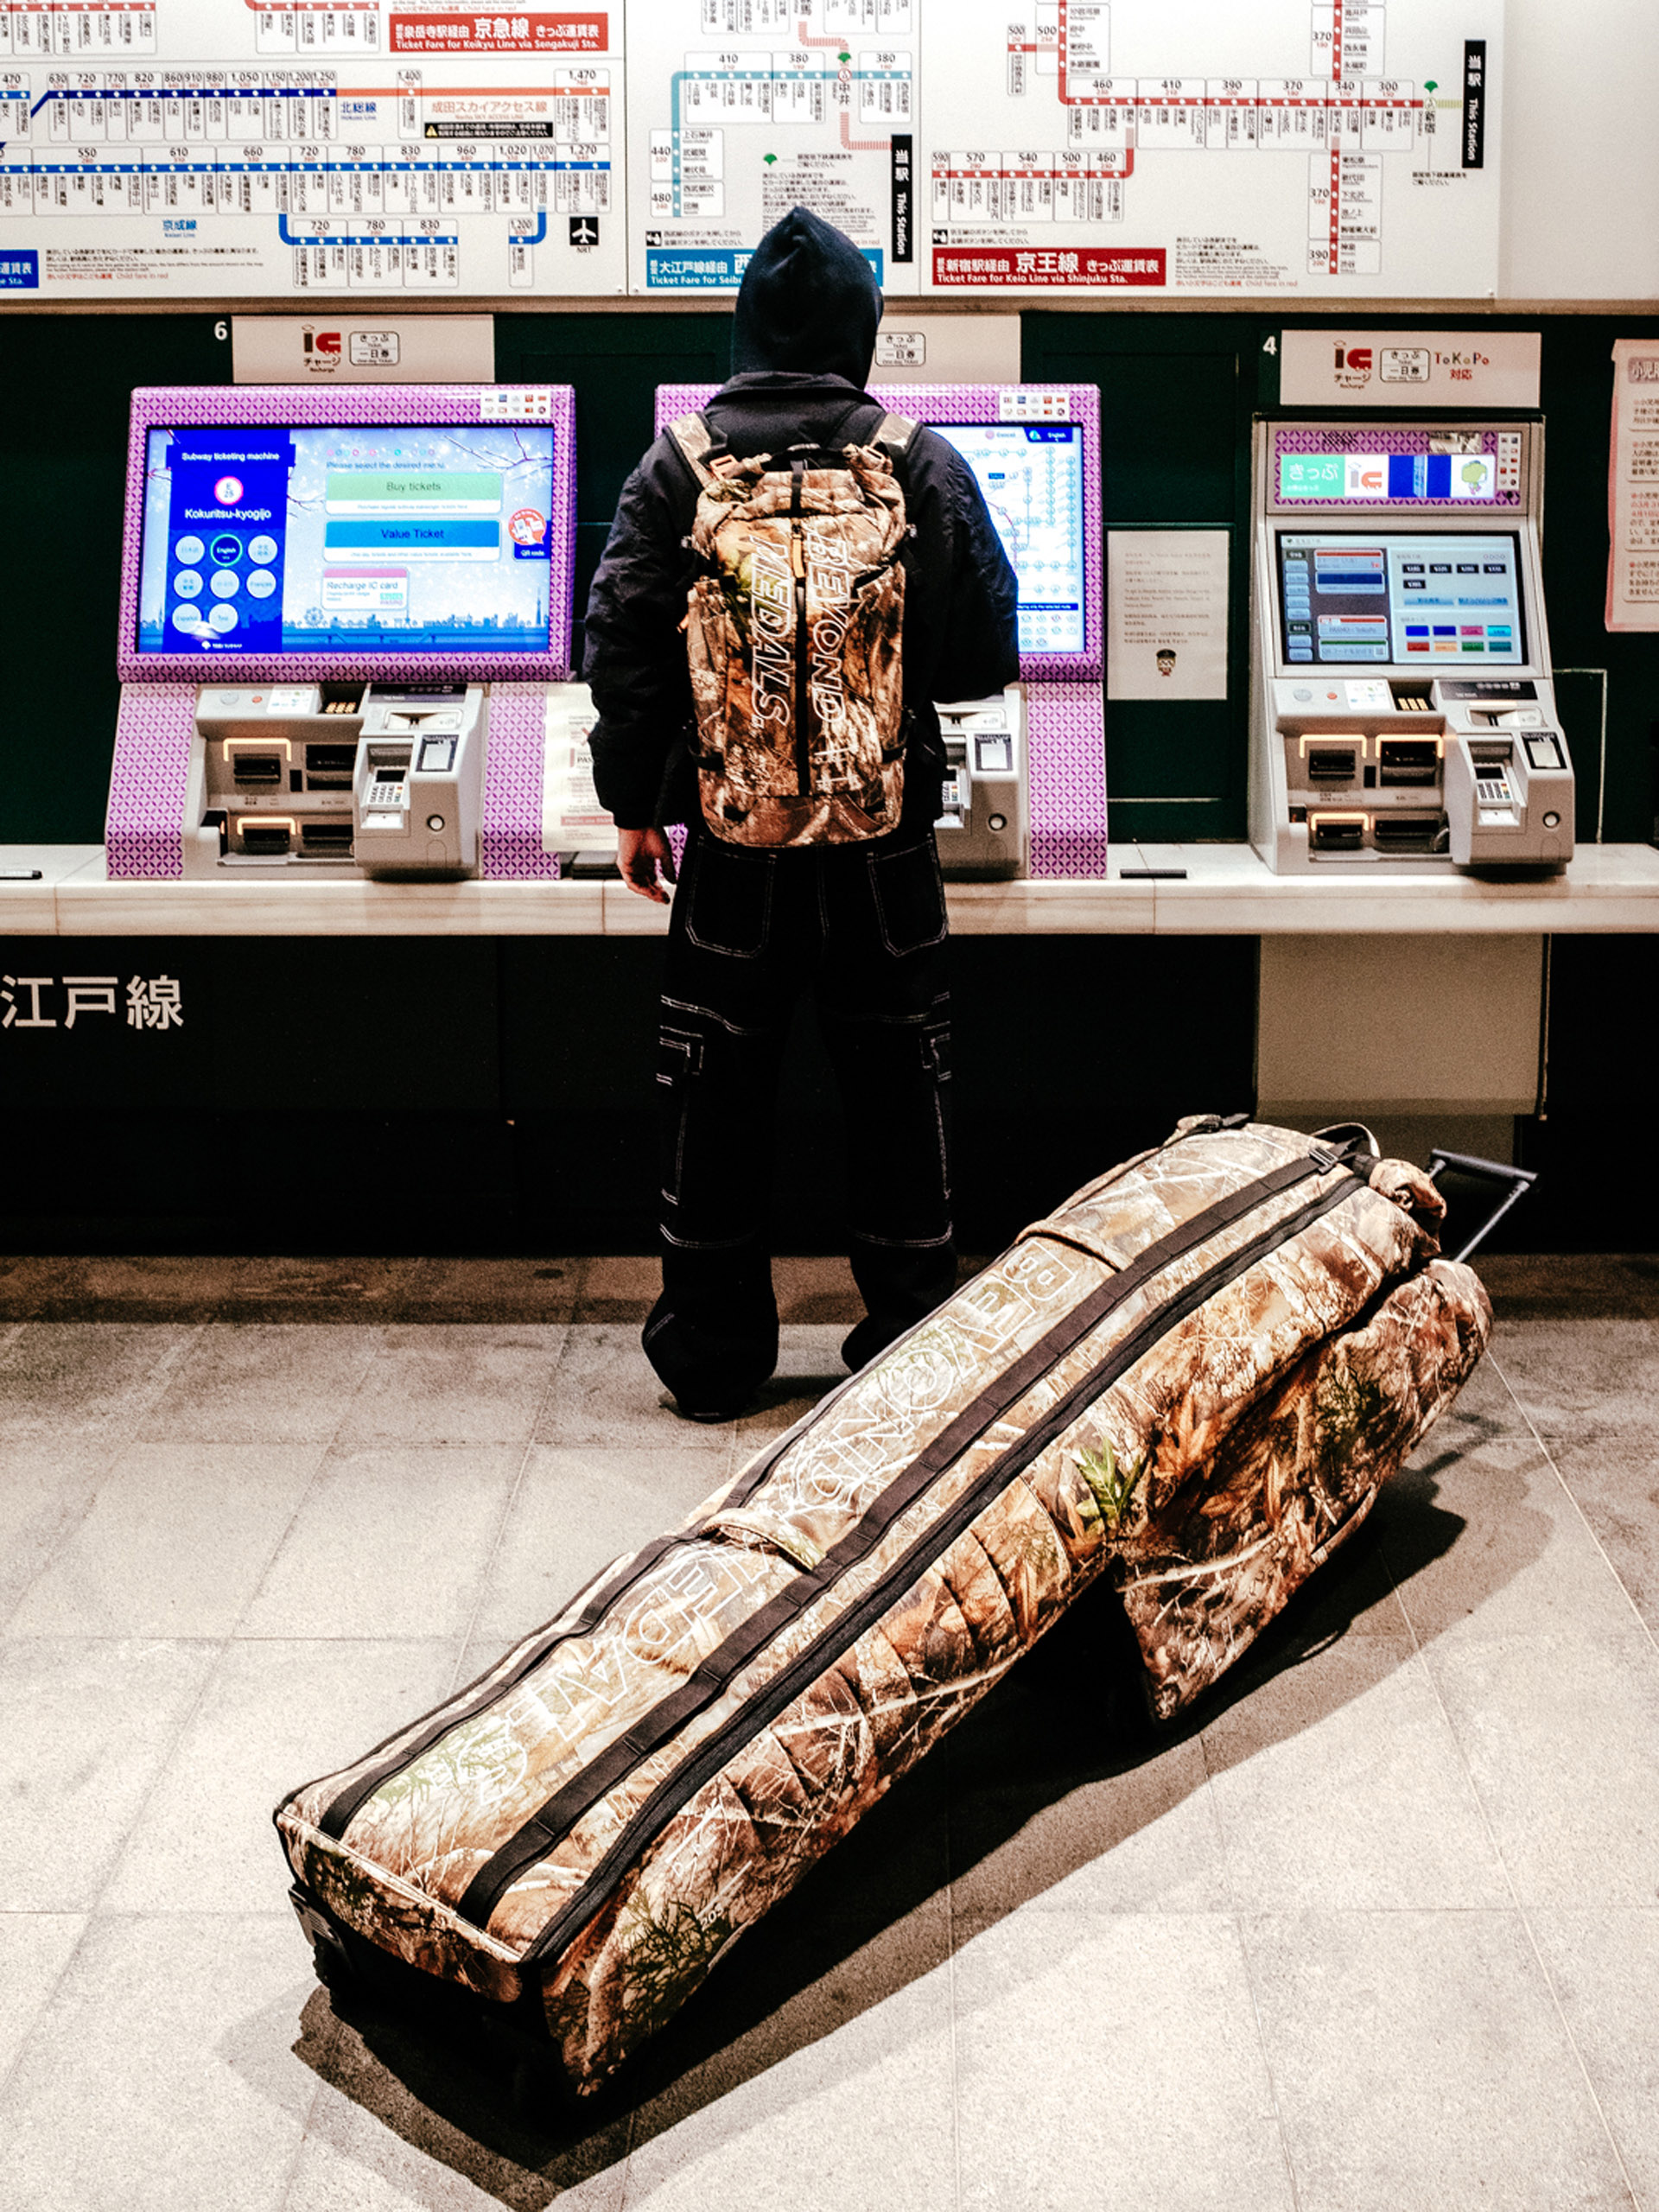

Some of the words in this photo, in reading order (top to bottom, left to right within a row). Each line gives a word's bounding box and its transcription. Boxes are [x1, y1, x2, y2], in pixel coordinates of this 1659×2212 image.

[474, 16, 530, 39] 京急線
[537, 24, 600, 37] きっぷ運賃表
[1037, 26, 1057, 35] 500
[1313, 31, 1332, 41] 370
[396, 40, 423, 49] Ticket
[425, 40, 444, 49] Fare
[448, 40, 461, 49] for
[463, 40, 494, 50] Keikyu
[497, 40, 516, 48] Line
[518, 40, 532, 48] via
[535, 39, 579, 50] Sengakuji
[581, 39, 600, 48] Sta.
[719, 54, 739, 63] 410
[789, 54, 809, 63] 380
[876, 54, 896, 63] 380
[569, 70, 597, 80] 1,470
[1468, 55, 1481, 86] 当駅
[3, 73, 21, 83] 470
[49, 73, 67, 83] 630
[78, 73, 96, 83] 720
[108, 73, 124, 83] 770
[135, 73, 154, 83] 820
[165, 73, 182, 82] 860
[185, 73, 202, 82] 910
[207, 73, 224, 82] 980
[232, 73, 259, 82] 1,050
[313, 73, 335, 82] 1,250
[1092, 79, 1113, 89] 460
[1161, 79, 1182, 89] 410
[1223, 80, 1242, 91] 390
[1284, 80, 1303, 91] 370
[1335, 80, 1354, 91] 340
[1379, 80, 1398, 91] 300
[840, 83, 850, 105] 中井
[341, 102, 377, 113] 北総線
[432, 101, 547, 112] 成田スカイアクセス線
[1468, 98, 1478, 120] This
[1467, 122, 1478, 161] Station
[78, 148, 97, 157] 550
[169, 148, 188, 157] 610
[243, 148, 263, 157] 660
[300, 146, 319, 156] 720
[346, 146, 365, 156] 780
[401, 146, 420, 156] 830
[456, 146, 476, 156] 960
[499, 146, 527, 156] 1,020
[570, 146, 596, 156] 1,270
[652, 146, 671, 156] 440
[933, 152, 950, 162] 590
[966, 152, 985, 162] 570
[1019, 152, 1037, 162] 540
[1063, 152, 1081, 162] 500
[1097, 152, 1116, 162] 460
[652, 193, 671, 202] 480
[1310, 188, 1330, 198] 370
[897, 192, 906, 214] This
[162, 219, 197, 231] 京成線
[311, 219, 330, 230] 720
[366, 219, 385, 230] 780
[420, 219, 440, 230] 830
[896, 216, 907, 256] Station
[1309, 250, 1328, 259] 390
[659, 261, 728, 274] 大江戸線経由
[946, 258, 1009, 273] 新宿駅経由
[1015, 251, 1079, 274] 京王線
[1087, 259, 1159, 273] きっぷ運賃表
[9, 276, 24, 285] Sta.
[651, 275, 678, 284] Ticket
[681, 275, 701, 283] Fare
[702, 275, 716, 283] for
[938, 274, 965, 283] Ticket
[967, 274, 987, 283] Fare
[989, 273, 1003, 283] for
[1006, 273, 1027, 283] Keio
[1029, 273, 1048, 283] Line
[1051, 274, 1065, 283] via
[1067, 274, 1108, 284] Shinjuku
[1109, 274, 1128, 283] Sta.
[214, 321, 228, 340] 6
[359, 334, 389, 343] きっぷ
[886, 334, 915, 344] きっぷ
[1262, 335, 1277, 355] 4
[359, 349, 389, 358] 一日券
[1391, 350, 1421, 359] きっぷ
[1434, 352, 1490, 365] ToKoPo
[304, 357, 341, 366] チャージ
[1390, 366, 1420, 375] 一日券
[1450, 368, 1472, 380] 対応
[1334, 372, 1371, 383] チャージ
[181, 452, 213, 461] Subway
[213, 452, 245, 462] ticketing
[247, 452, 280, 461] machine
[1288, 463, 1338, 480] きっぷ
[386, 481, 406, 493] Buy
[409, 481, 442, 491] tickets
[185, 508, 271, 521] Kokuritsu-kyogijo
[380, 529, 410, 539] Value
[415, 529, 445, 539] Ticket
[327, 582, 366, 591] Recharge
[380, 582, 398, 590] card
[749, 535, 792, 727] MEDALS
[807, 531, 850, 724] BEYOND
[1, 974, 184, 1030] 江戸線
[795, 1239, 1077, 1509] BEYOND
